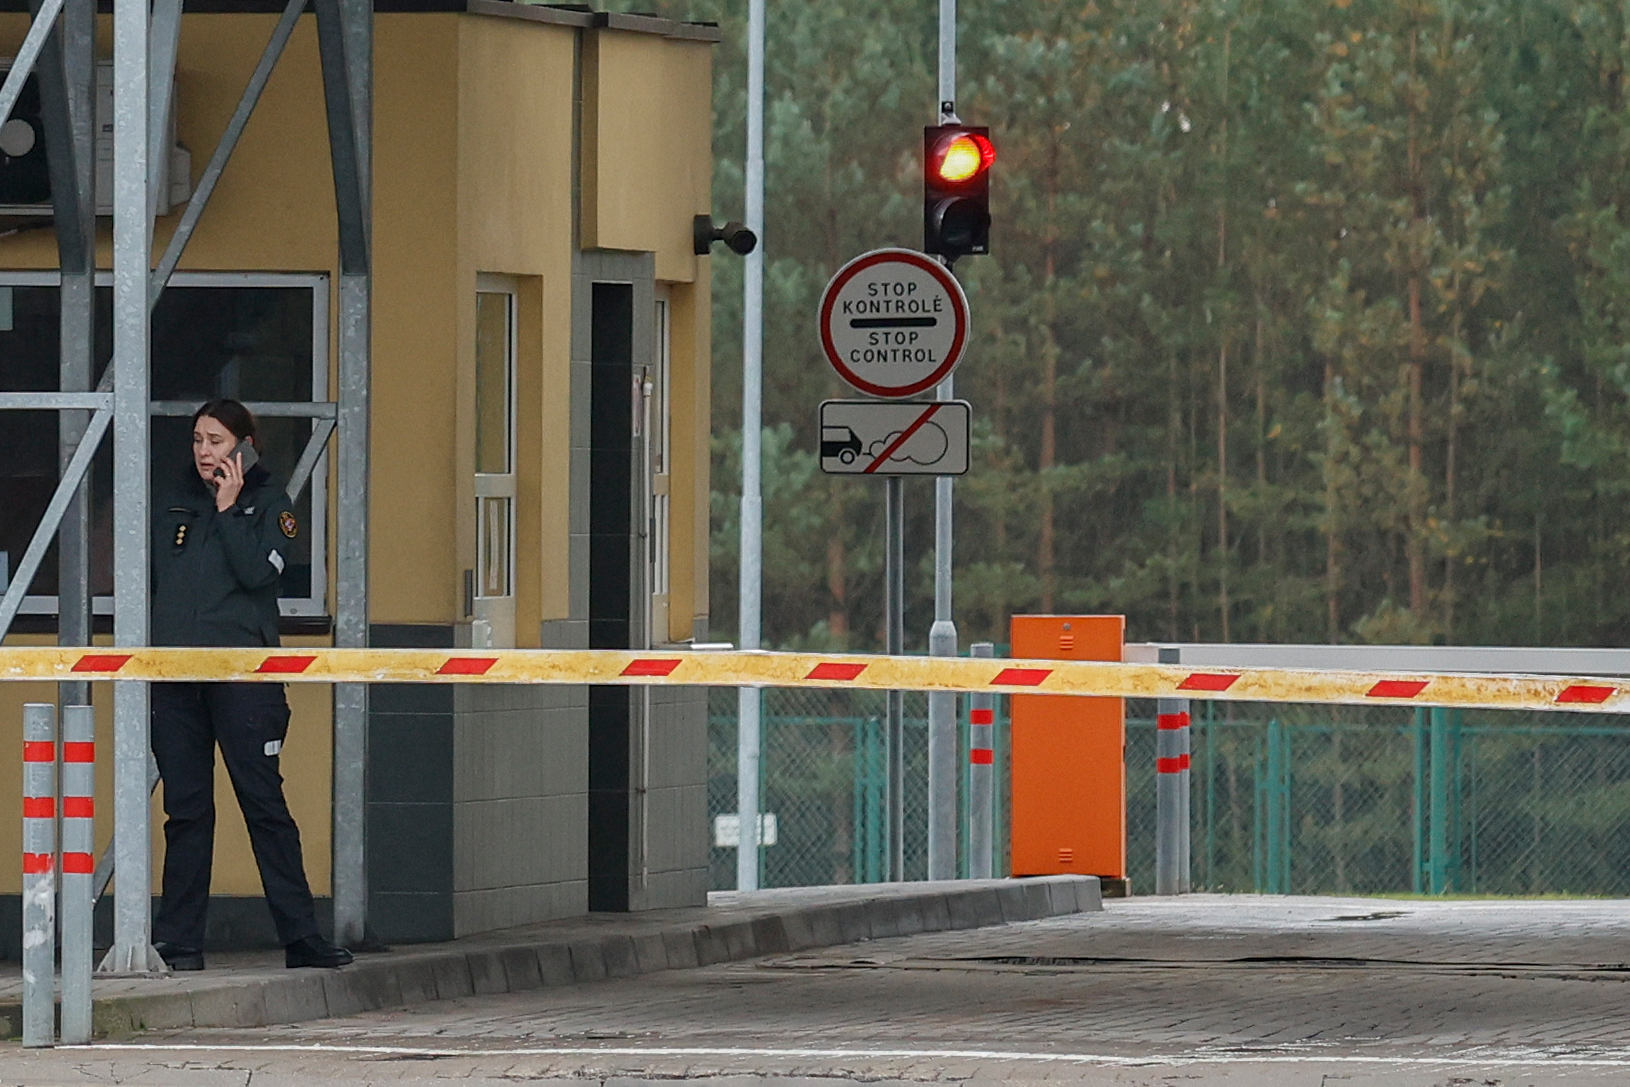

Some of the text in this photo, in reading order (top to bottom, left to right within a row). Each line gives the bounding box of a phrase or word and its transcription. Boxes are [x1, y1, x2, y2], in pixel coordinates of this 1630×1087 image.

[867, 282, 918, 296] STOP
[843, 295, 944, 314] KONTROLĖ
[868, 331, 920, 346] STOP
[850, 348, 938, 364] CONTROL
